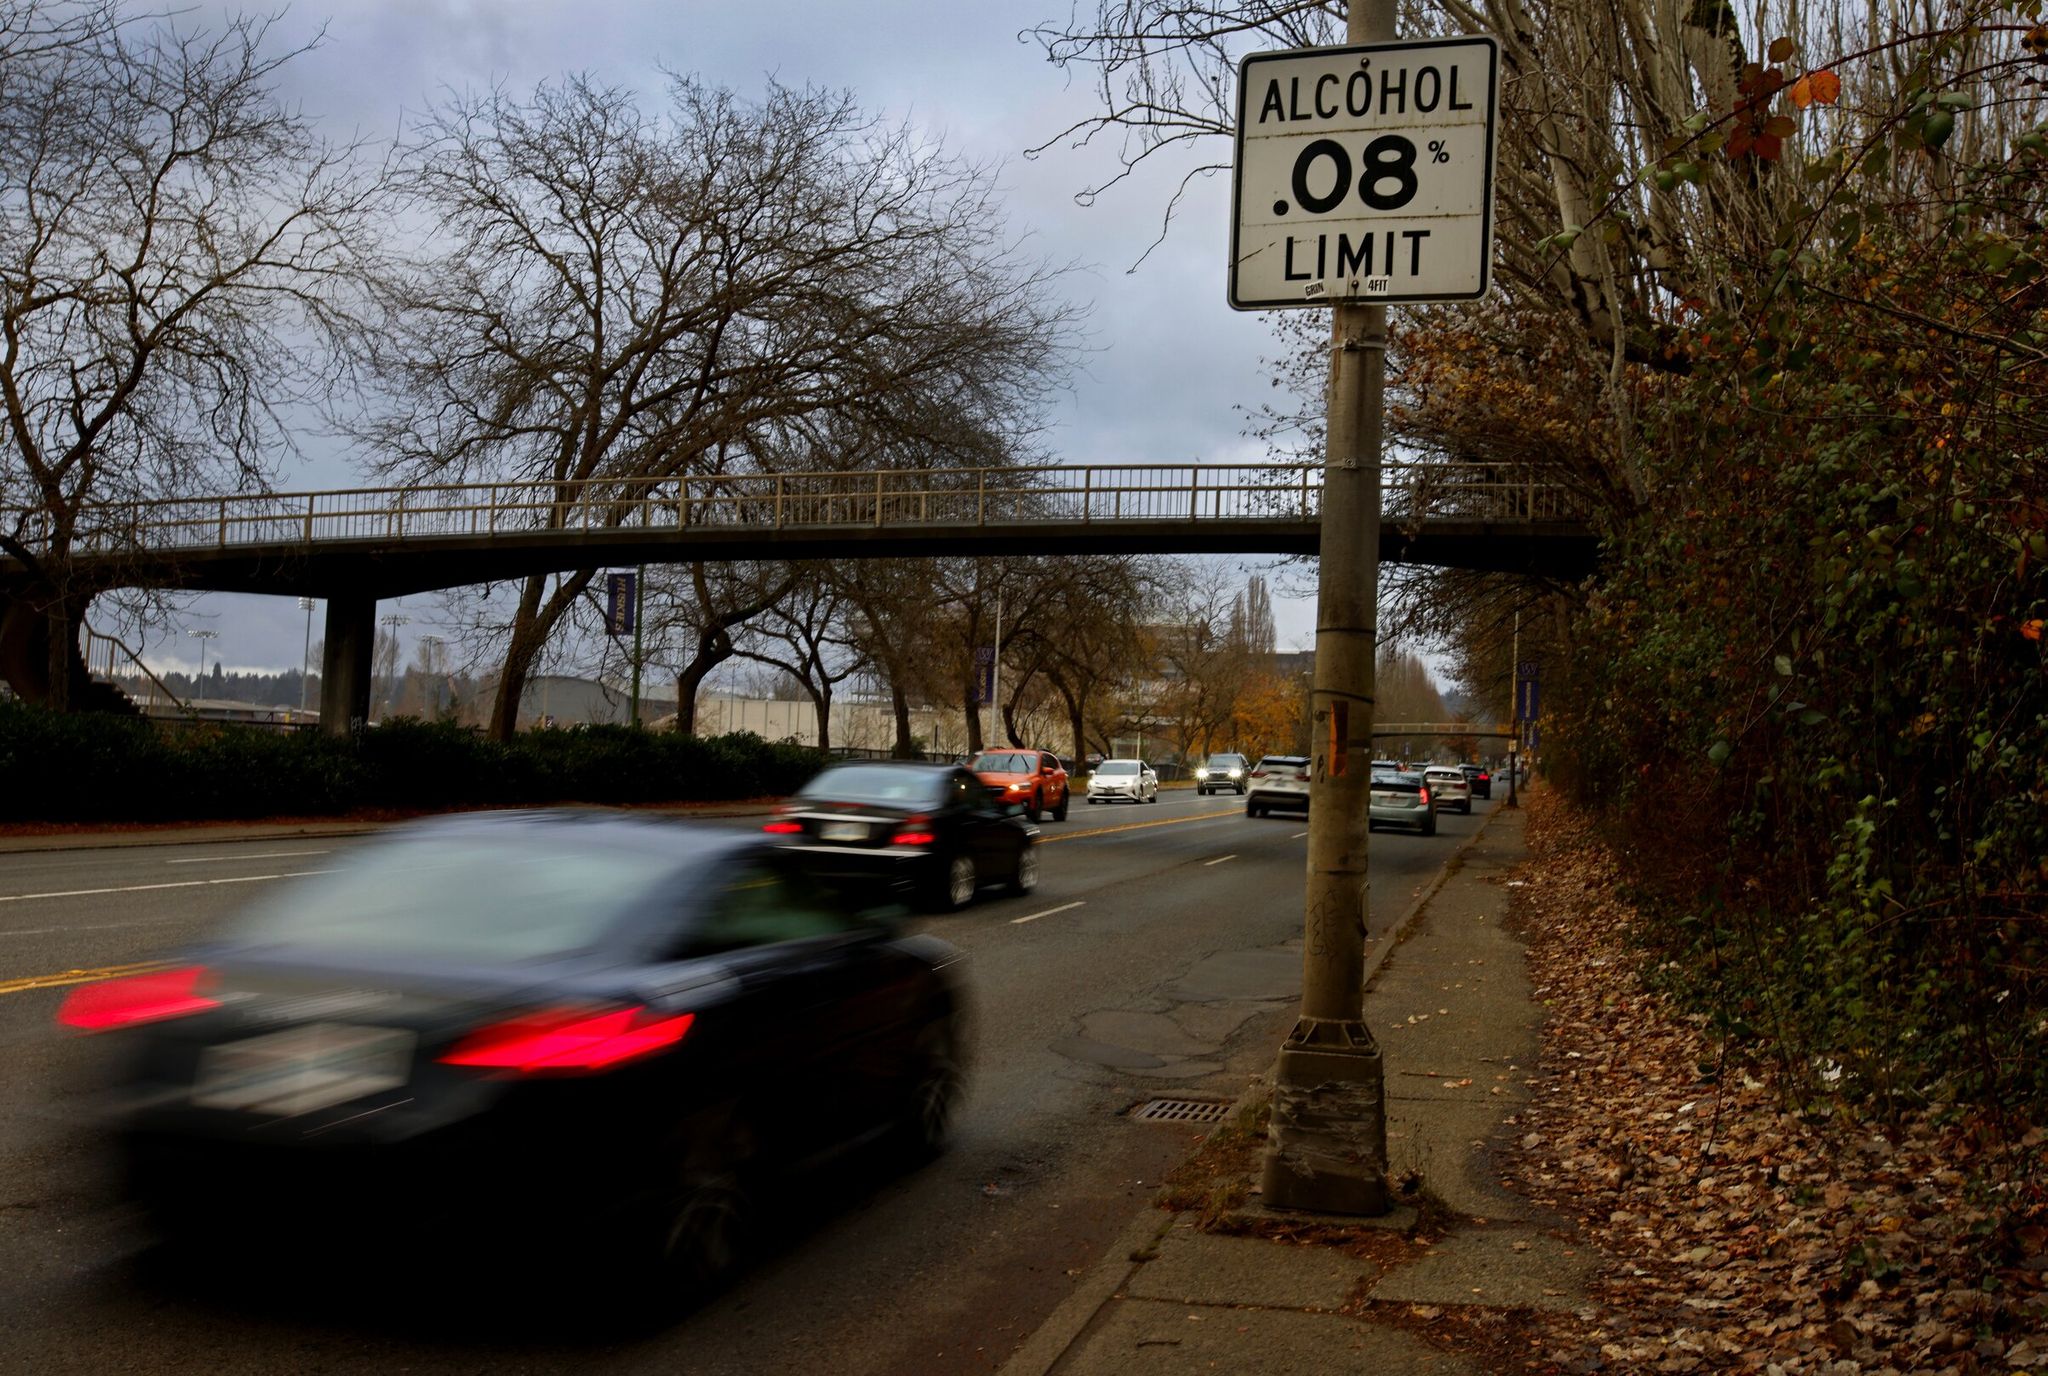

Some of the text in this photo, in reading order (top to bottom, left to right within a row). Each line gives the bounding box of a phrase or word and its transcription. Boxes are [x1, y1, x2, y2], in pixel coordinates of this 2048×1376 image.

[1259, 65, 1473, 124] ALCOHOL
[1284, 230, 1431, 281] LIMIT
[1367, 279, 1388, 292] 4FIT
[616, 577, 626, 632] HUSKIES
